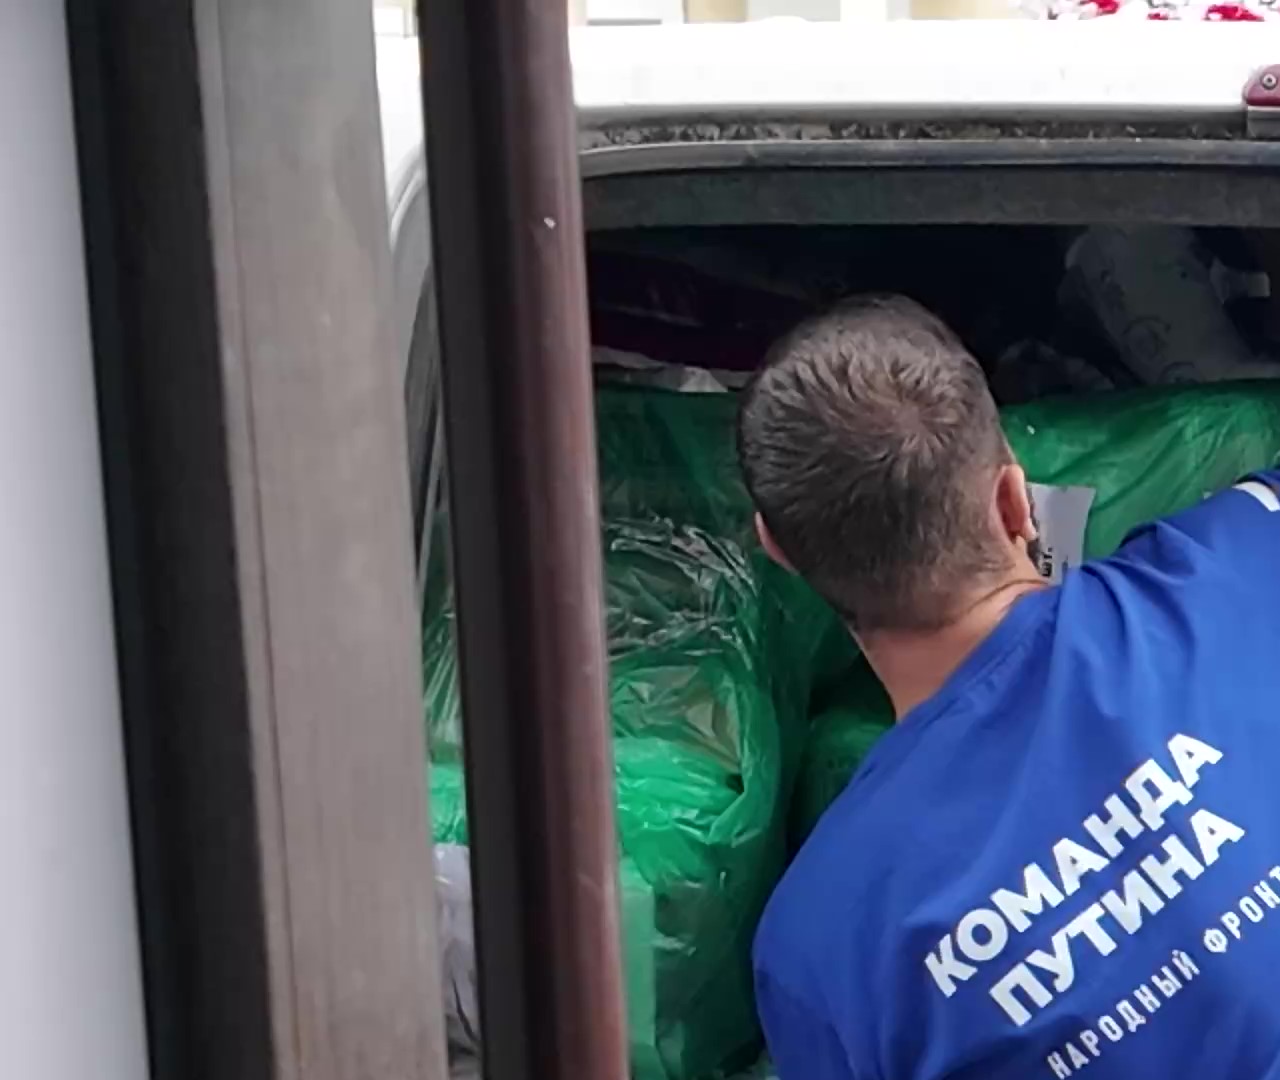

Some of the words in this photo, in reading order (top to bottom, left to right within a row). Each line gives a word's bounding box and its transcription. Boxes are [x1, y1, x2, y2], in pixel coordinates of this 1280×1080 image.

[924, 733, 1223, 998] КОМАНДА
[989, 808, 1245, 1027] ПУТИНА
[1046, 949, 1200, 1080] НАРОДНЫЙ
